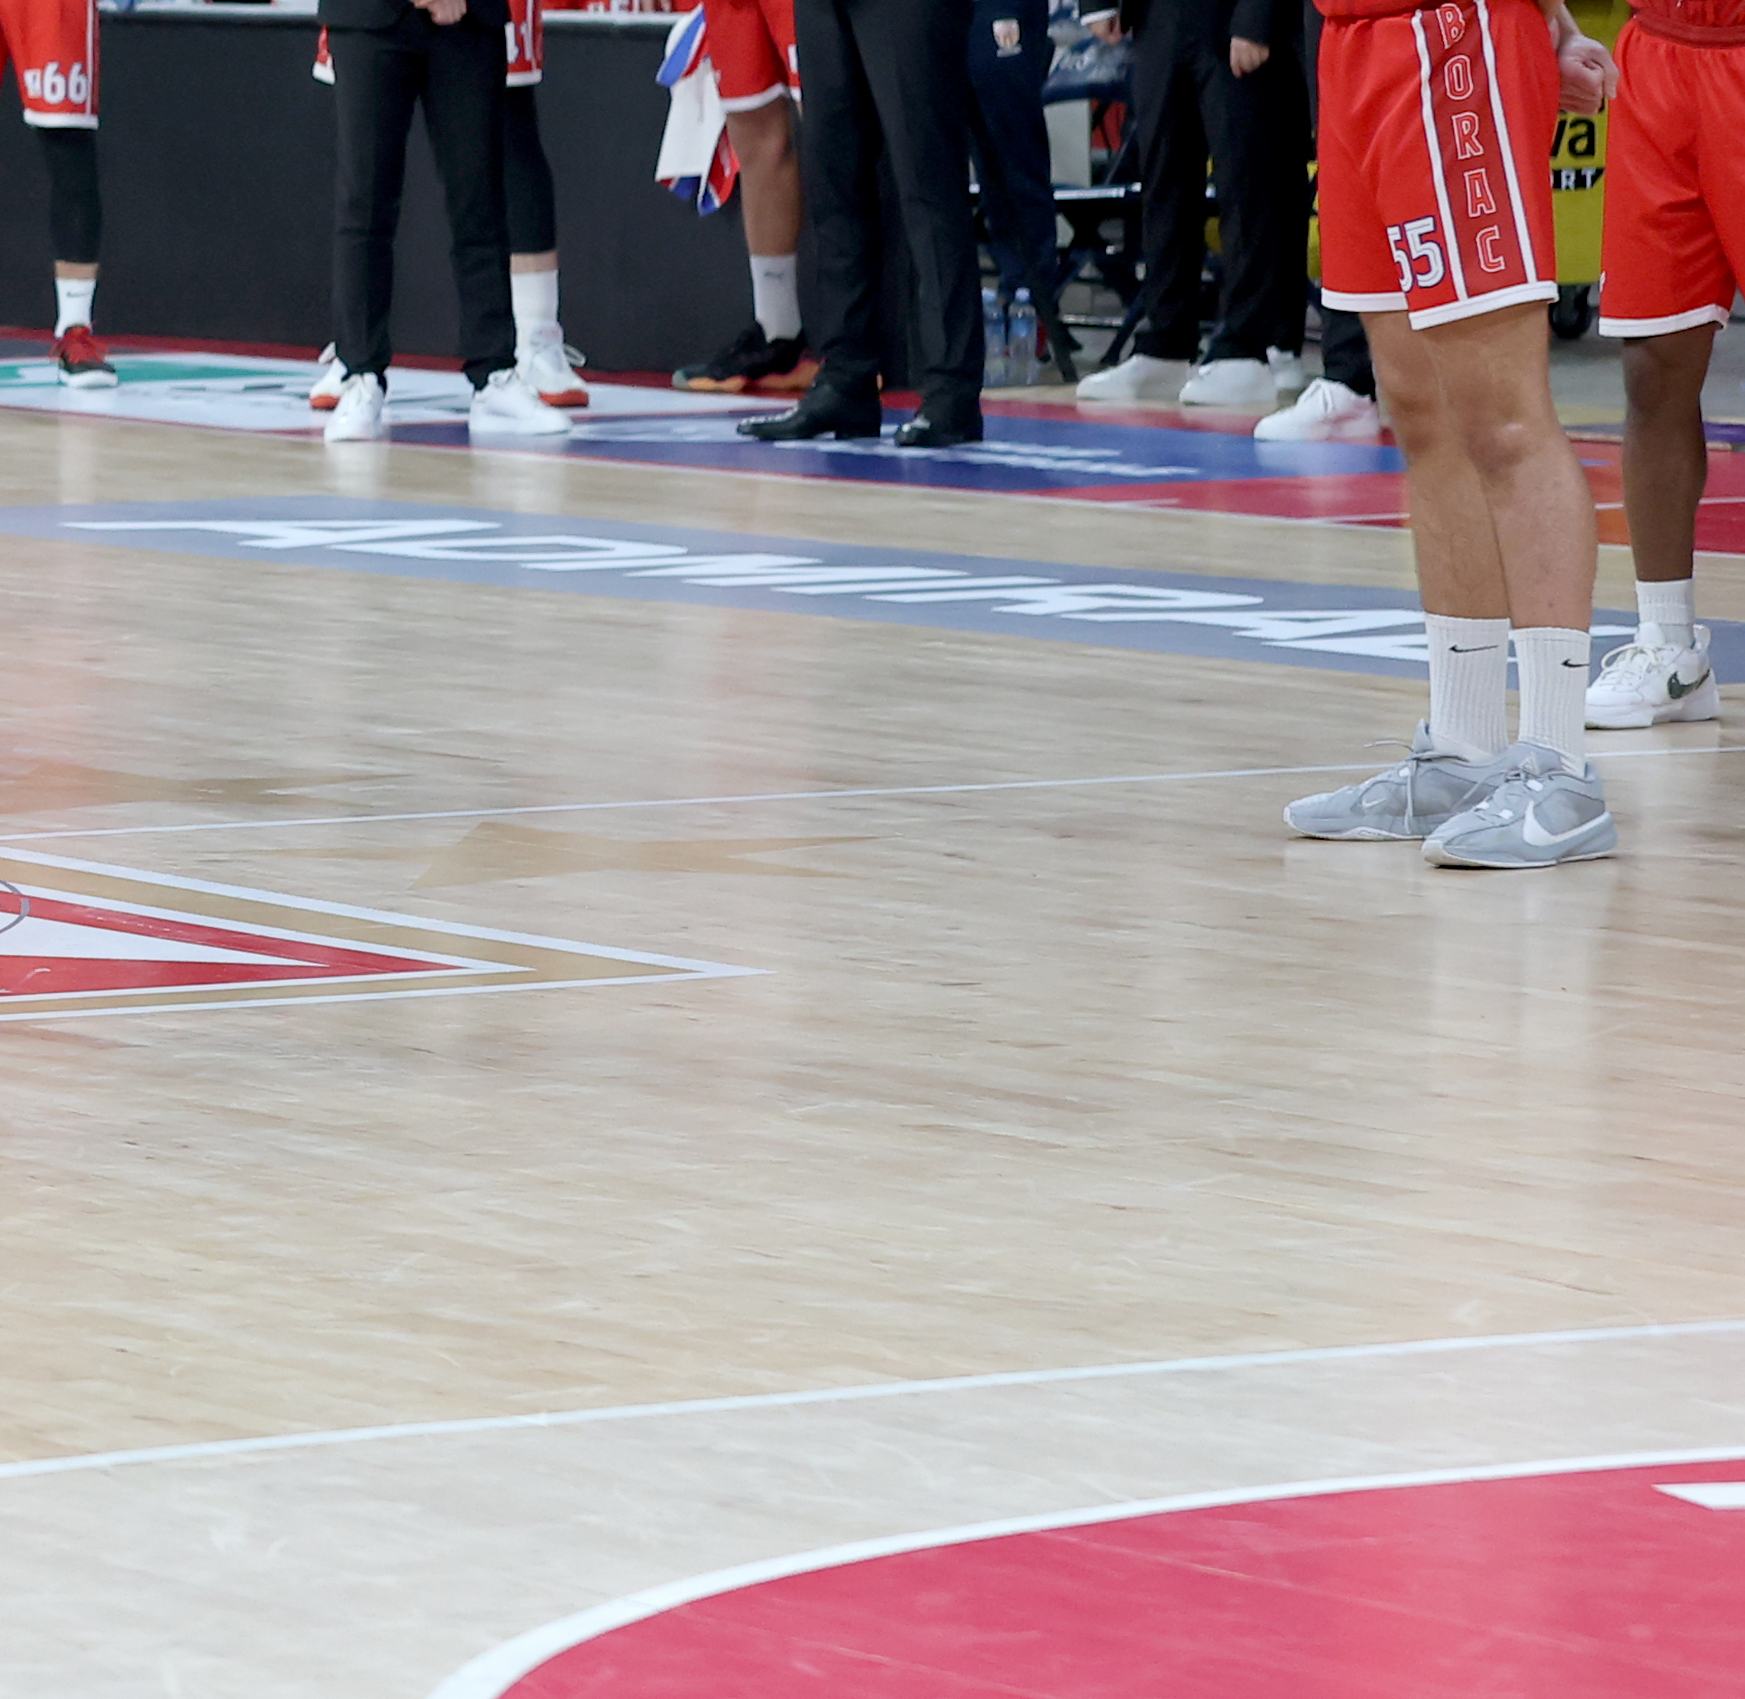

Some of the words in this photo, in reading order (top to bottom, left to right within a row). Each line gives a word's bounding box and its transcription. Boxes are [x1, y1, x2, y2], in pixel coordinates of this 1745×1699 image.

[41, 61, 90, 106] 66
[1435, 3, 1506, 273] BORAC
[1387, 215, 1446, 293] 55
